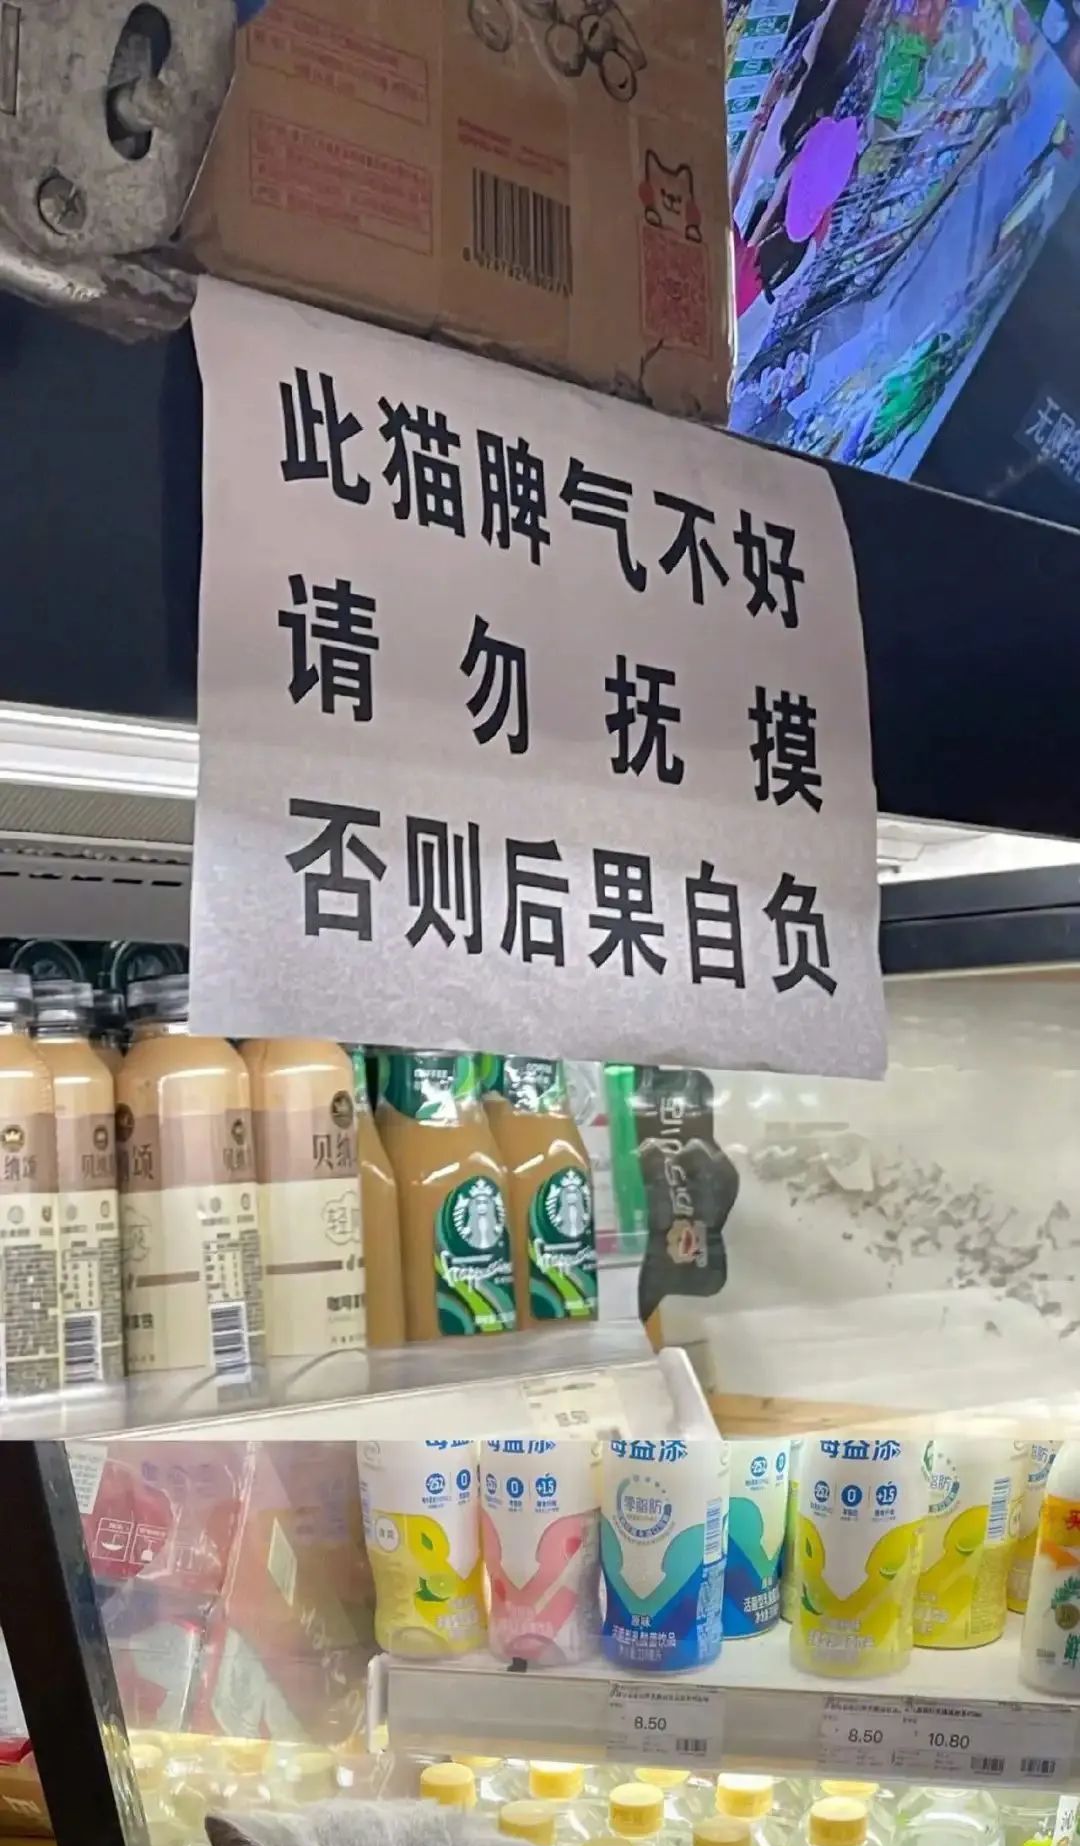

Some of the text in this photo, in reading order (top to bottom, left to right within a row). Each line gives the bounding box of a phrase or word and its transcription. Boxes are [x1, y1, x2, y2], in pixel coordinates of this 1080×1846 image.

[279, 366, 806, 629] 此猫脾气不好
[278, 573, 823, 813] 请勿抚摸
[285, 797, 838, 997] 否则后果自负
[633, 1715, 667, 1732] 8.50
[848, 1728, 884, 1744] 8.50
[928, 1731, 970, 1750] 10.80
